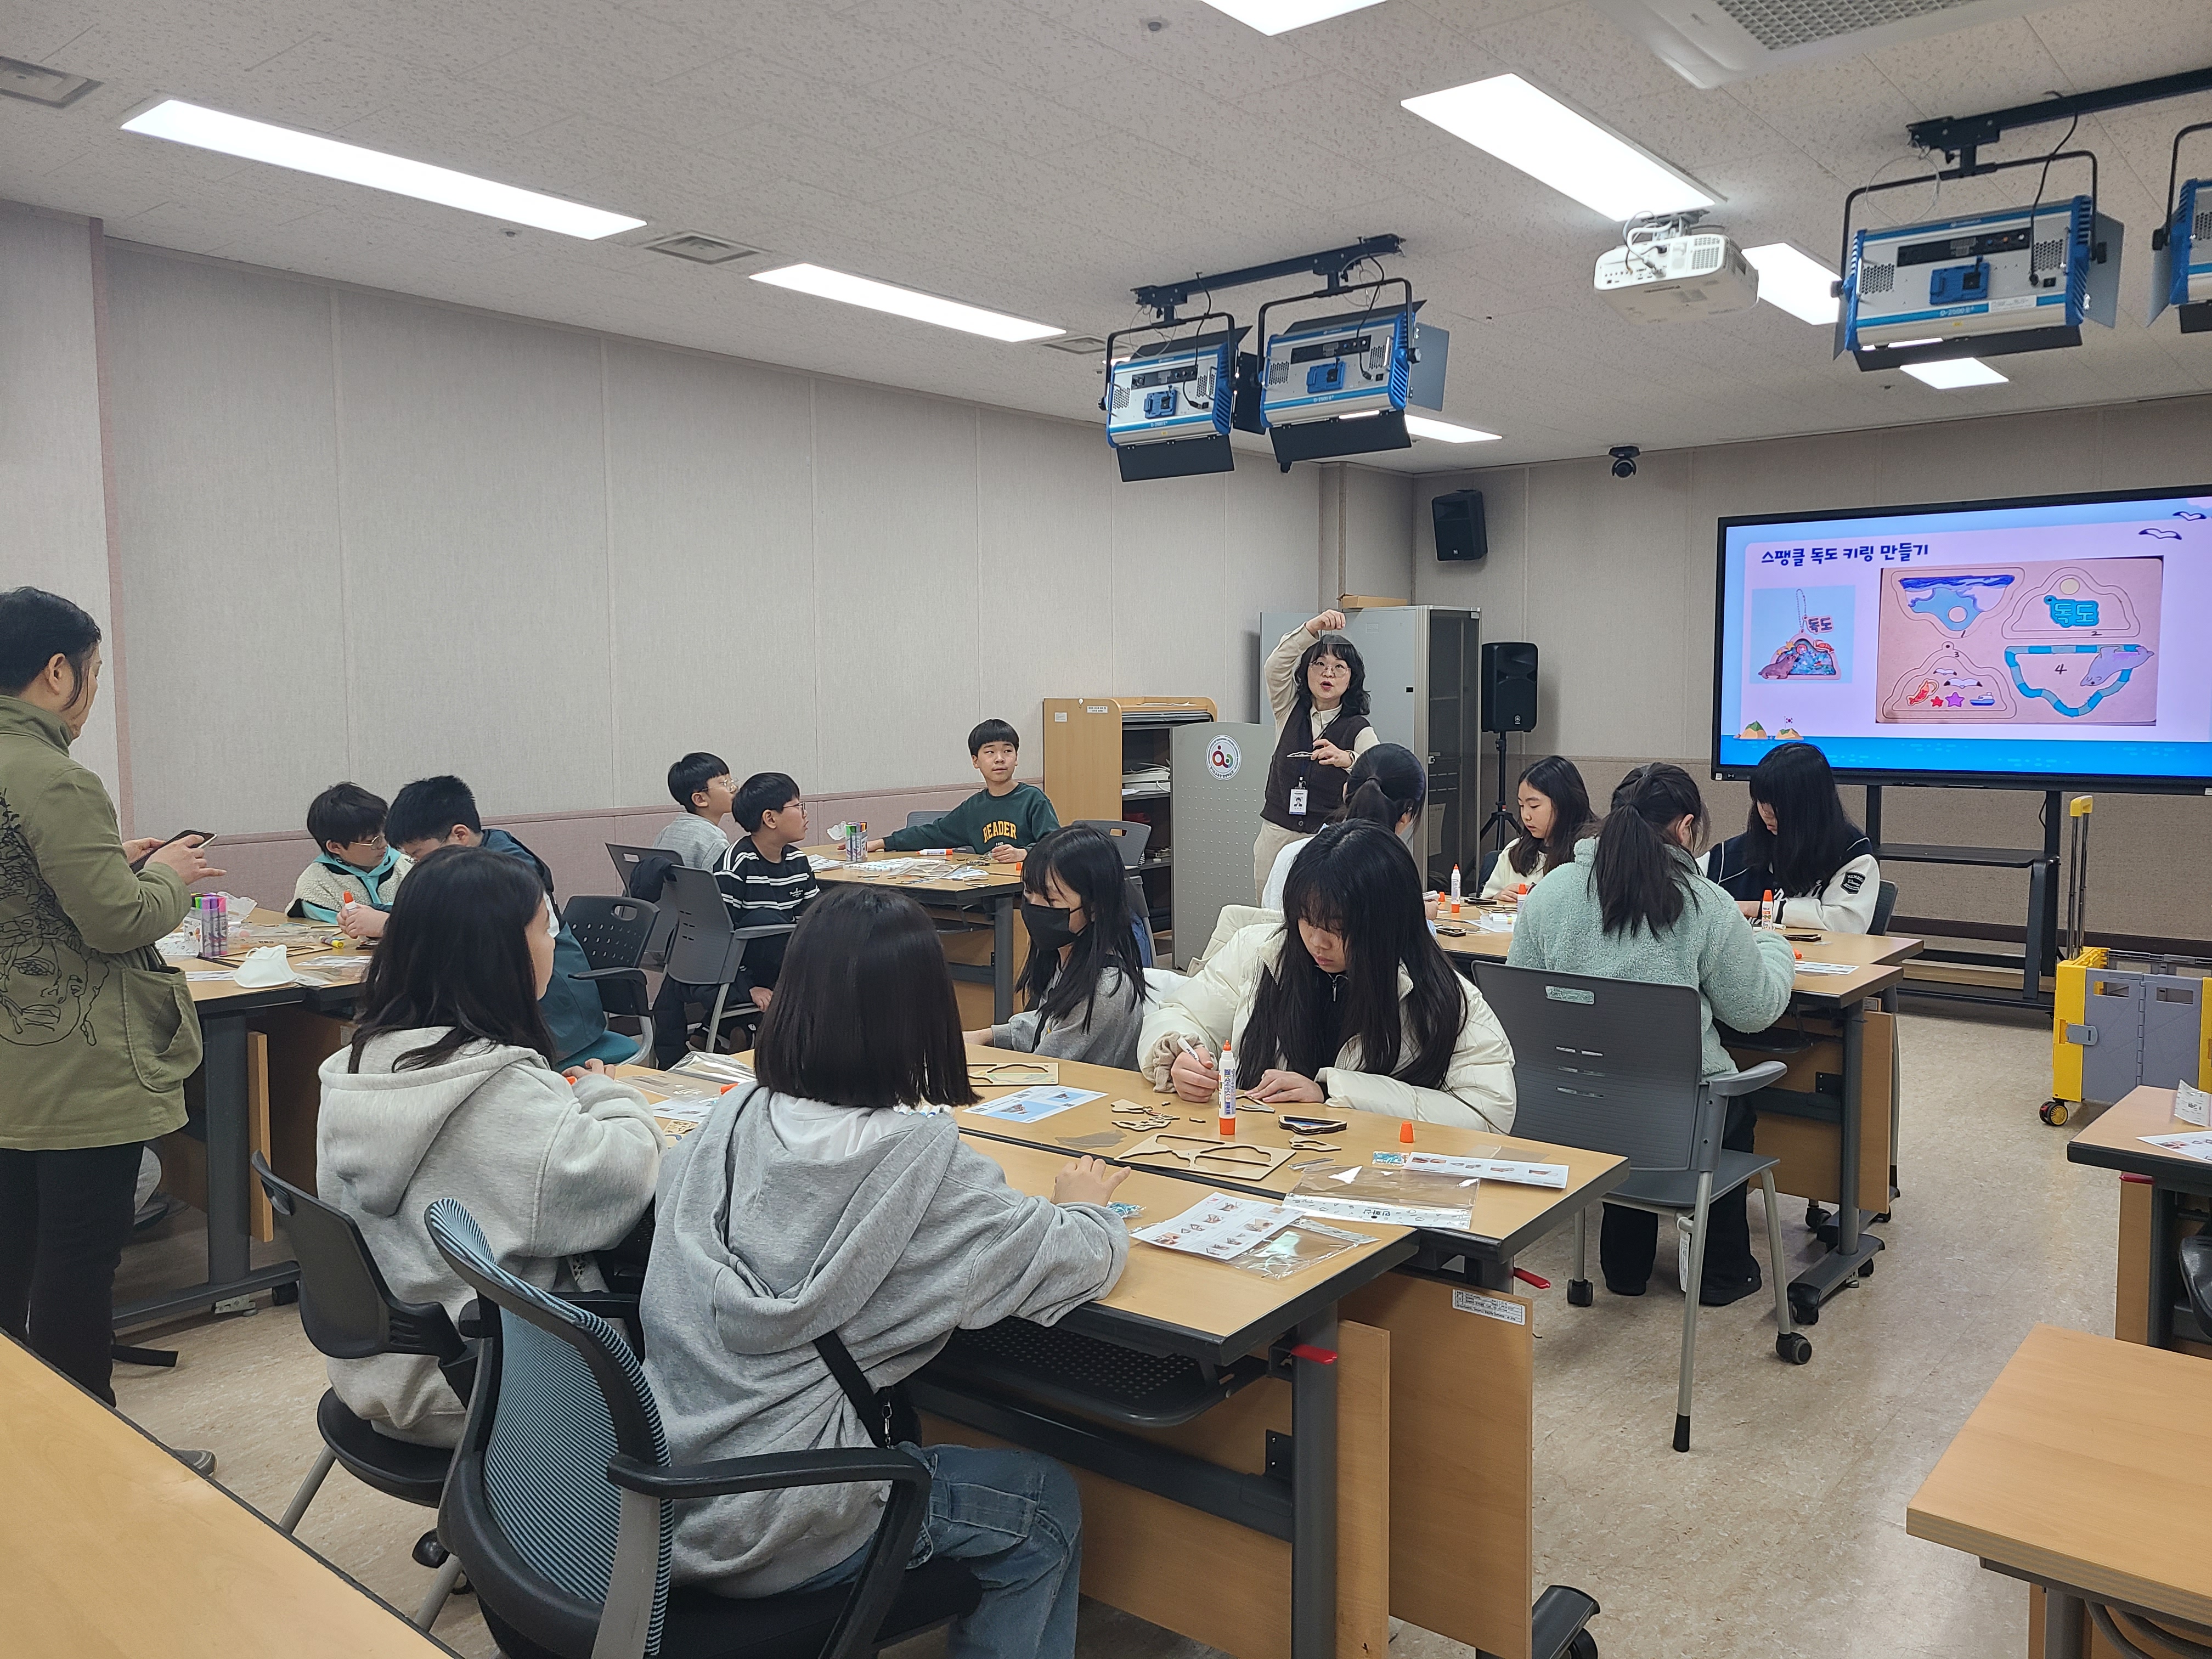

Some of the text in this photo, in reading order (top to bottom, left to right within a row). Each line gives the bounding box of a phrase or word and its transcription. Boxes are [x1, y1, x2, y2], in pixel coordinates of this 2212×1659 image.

[1761, 542, 1928, 567] 스팽클 독도 키링 만들기
[2055, 602, 2094, 624] 독도
[1808, 617, 1832, 633] 독도
[2055, 663, 2068, 675] 4
[983, 821, 1017, 843] READER
